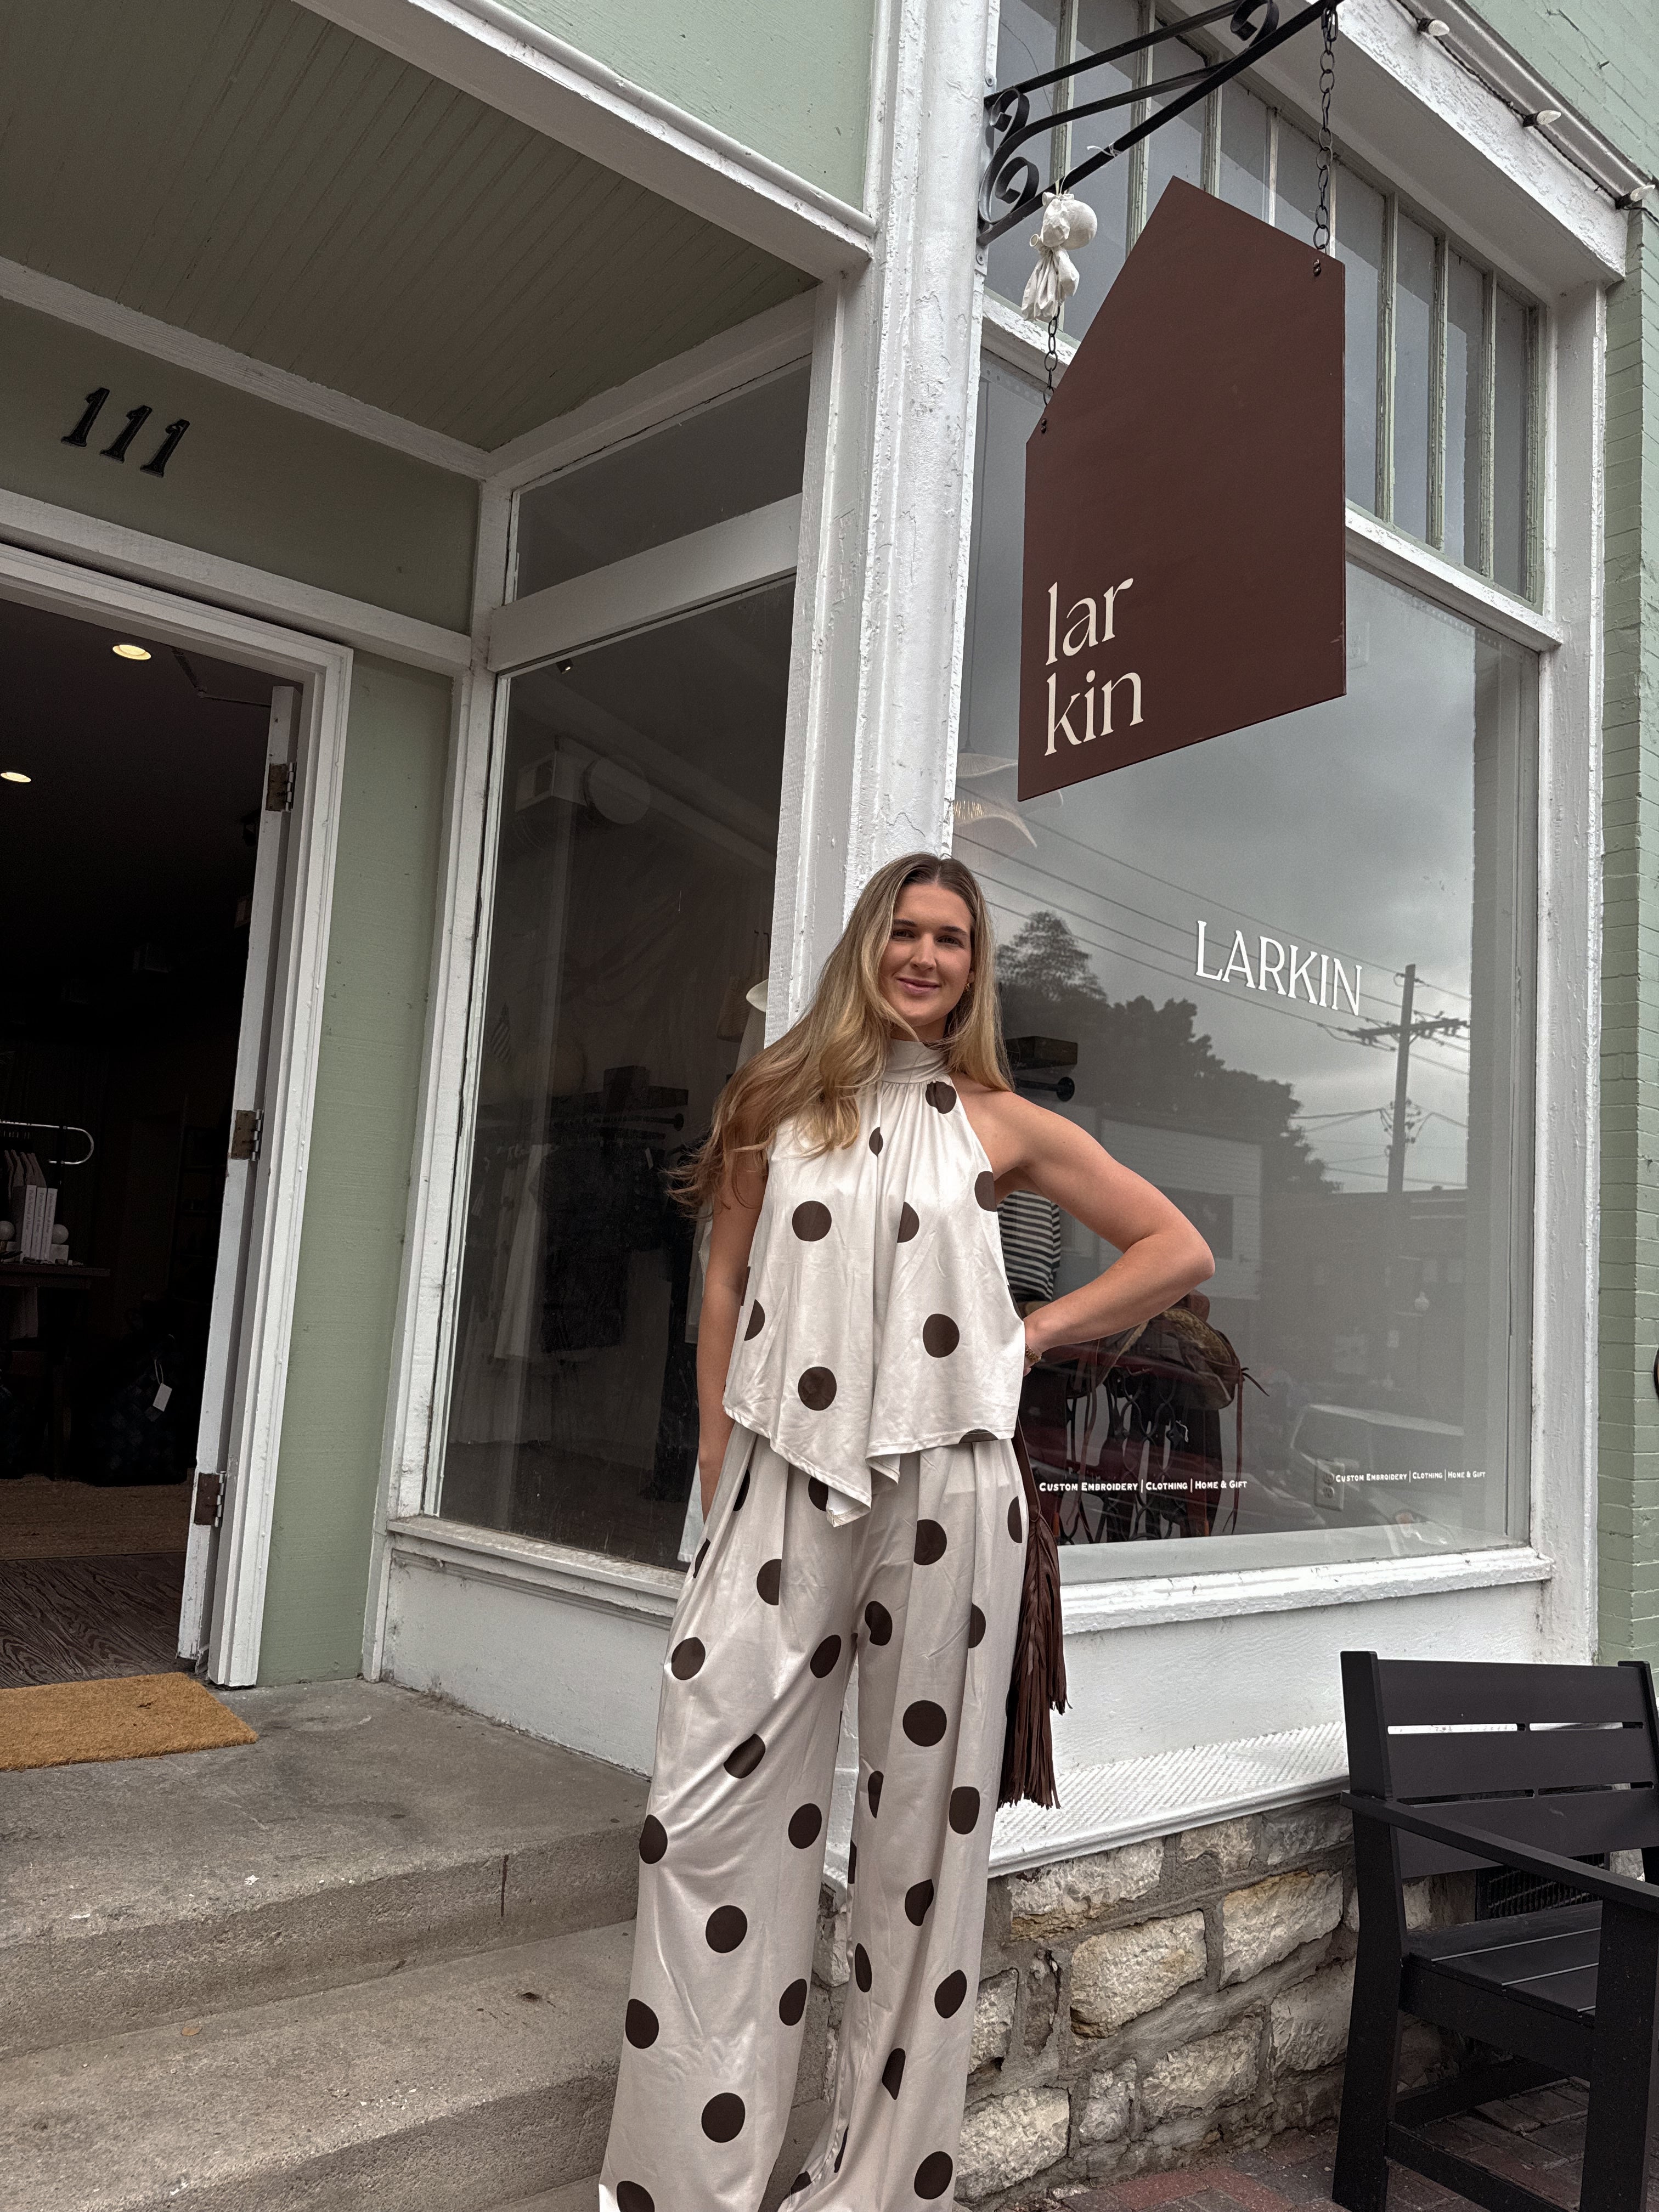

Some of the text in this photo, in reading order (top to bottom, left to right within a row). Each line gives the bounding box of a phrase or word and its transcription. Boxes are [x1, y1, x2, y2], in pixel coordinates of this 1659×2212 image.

[60, 387, 190, 478] 111
[1045, 578, 1134, 666] lar
[1044, 670, 1144, 757] kin
[1195, 920, 1362, 1015] LARKIN
[1039, 1480, 1248, 1492] CUSTOM EMBROIDERY CLOTHING HOME & GIFT
